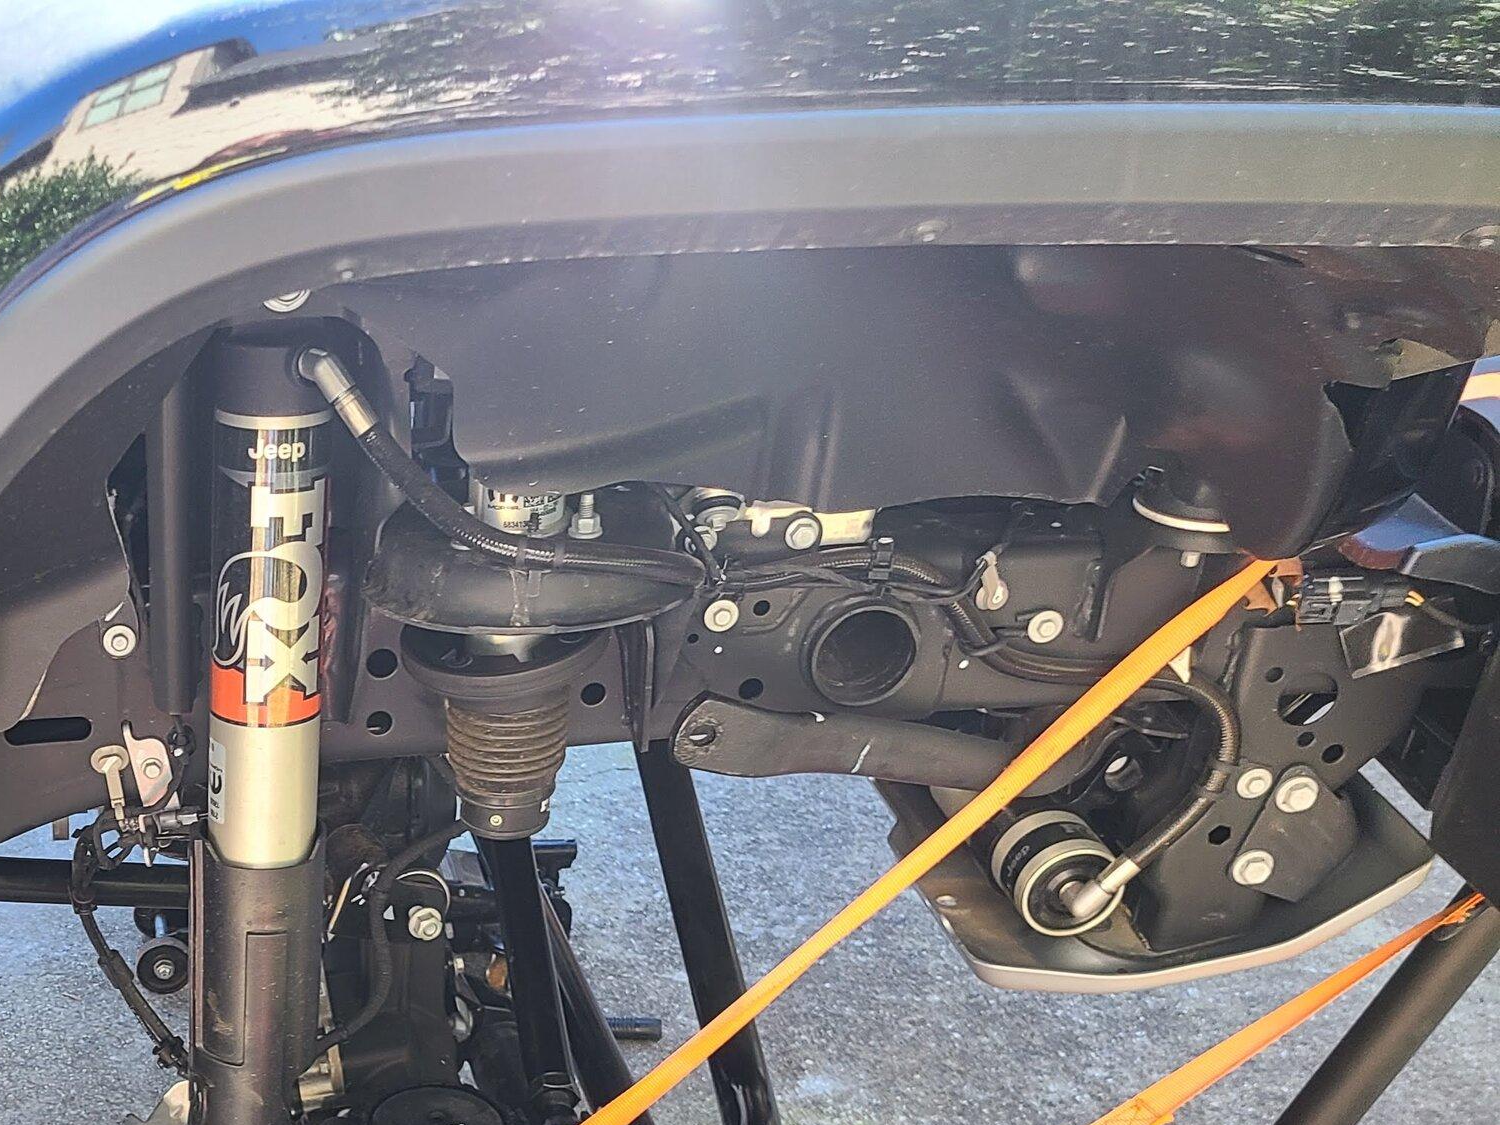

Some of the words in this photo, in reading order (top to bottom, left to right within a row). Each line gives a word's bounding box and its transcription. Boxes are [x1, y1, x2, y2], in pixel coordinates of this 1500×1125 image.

[248, 441, 306, 462] Jeep
[244, 476, 326, 704] FOX
[1007, 845, 1030, 878] Jeep
